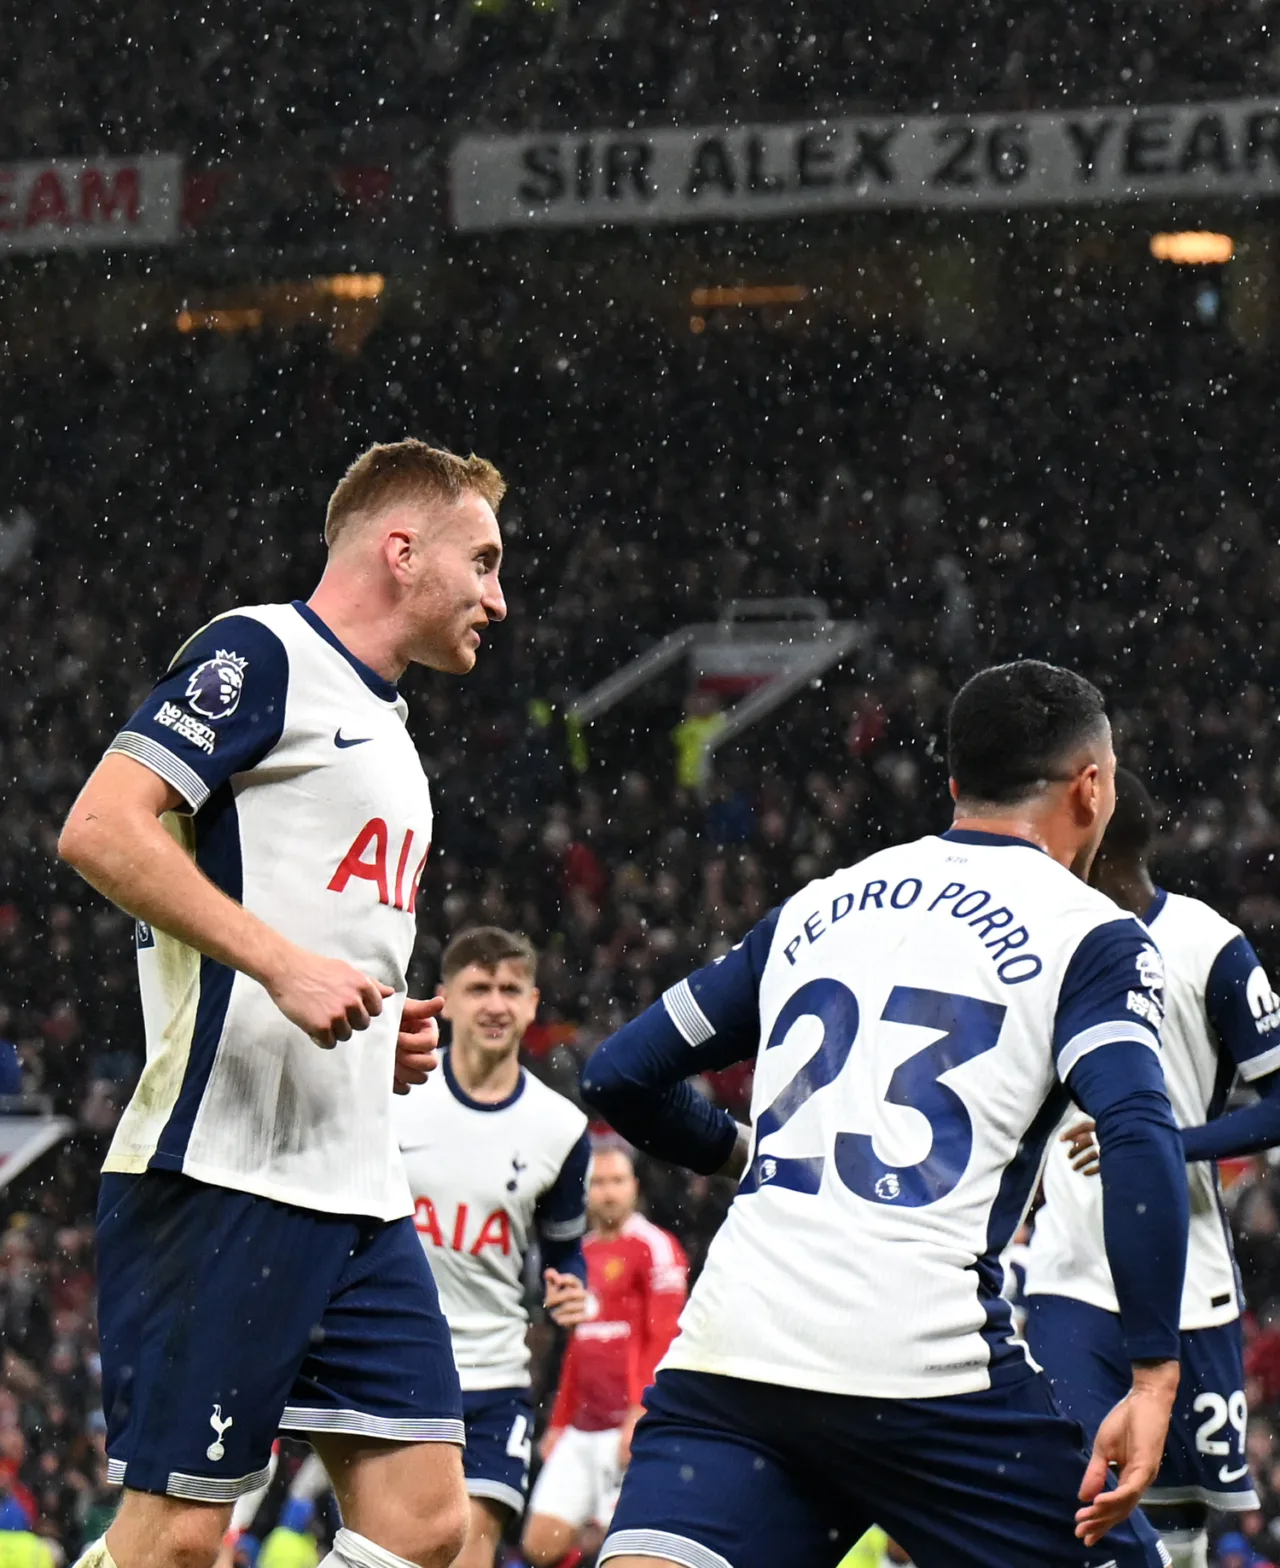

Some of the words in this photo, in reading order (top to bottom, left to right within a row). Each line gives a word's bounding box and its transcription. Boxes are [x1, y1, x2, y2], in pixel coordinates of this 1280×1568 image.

[517, 138, 655, 206] SIR
[685, 127, 897, 198] ALEX
[932, 120, 1029, 187] 26
[155, 701, 182, 720] No
[180, 713, 216, 742] room
[172, 722, 214, 755] racism
[783, 878, 923, 966] PEDRO
[927, 882, 1043, 985] PORRO
[734, 977, 1008, 1208] 23
[412, 1194, 511, 1257] AIA
[505, 1413, 535, 1470] 4
[1193, 1389, 1249, 1456] 29
